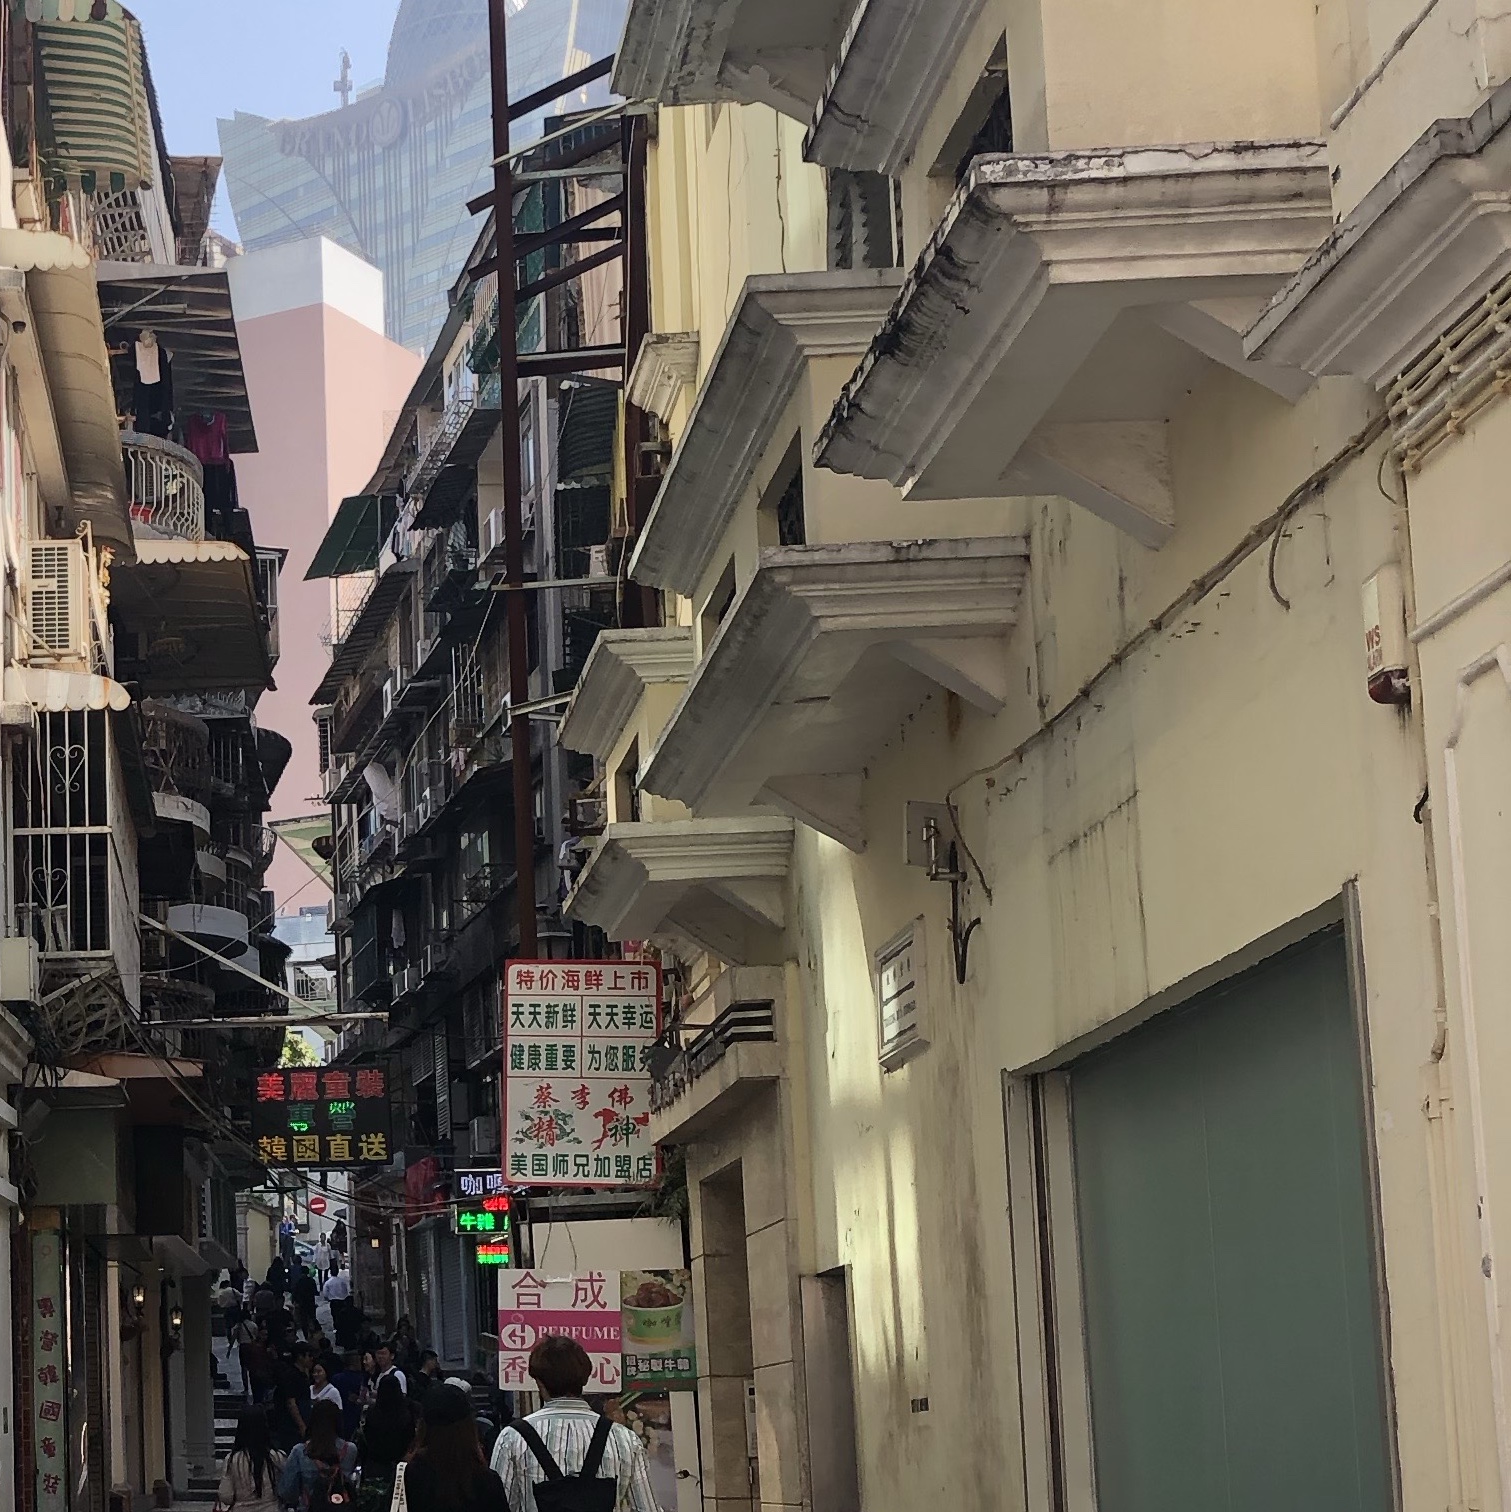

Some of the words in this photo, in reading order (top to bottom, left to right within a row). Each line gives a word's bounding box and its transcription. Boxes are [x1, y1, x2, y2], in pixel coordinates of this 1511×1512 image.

[515, 969, 650, 991] 特价海鲜上市
[510, 1002, 577, 1030] 天天新鲜
[587, 1003, 655, 1031] 天天幸运
[509, 1043, 577, 1072] 健康重要
[257, 1132, 388, 1164] 韓國直送
[510, 1151, 654, 1180] 美国师兄加盟店
[511, 1270, 608, 1309] 合成
